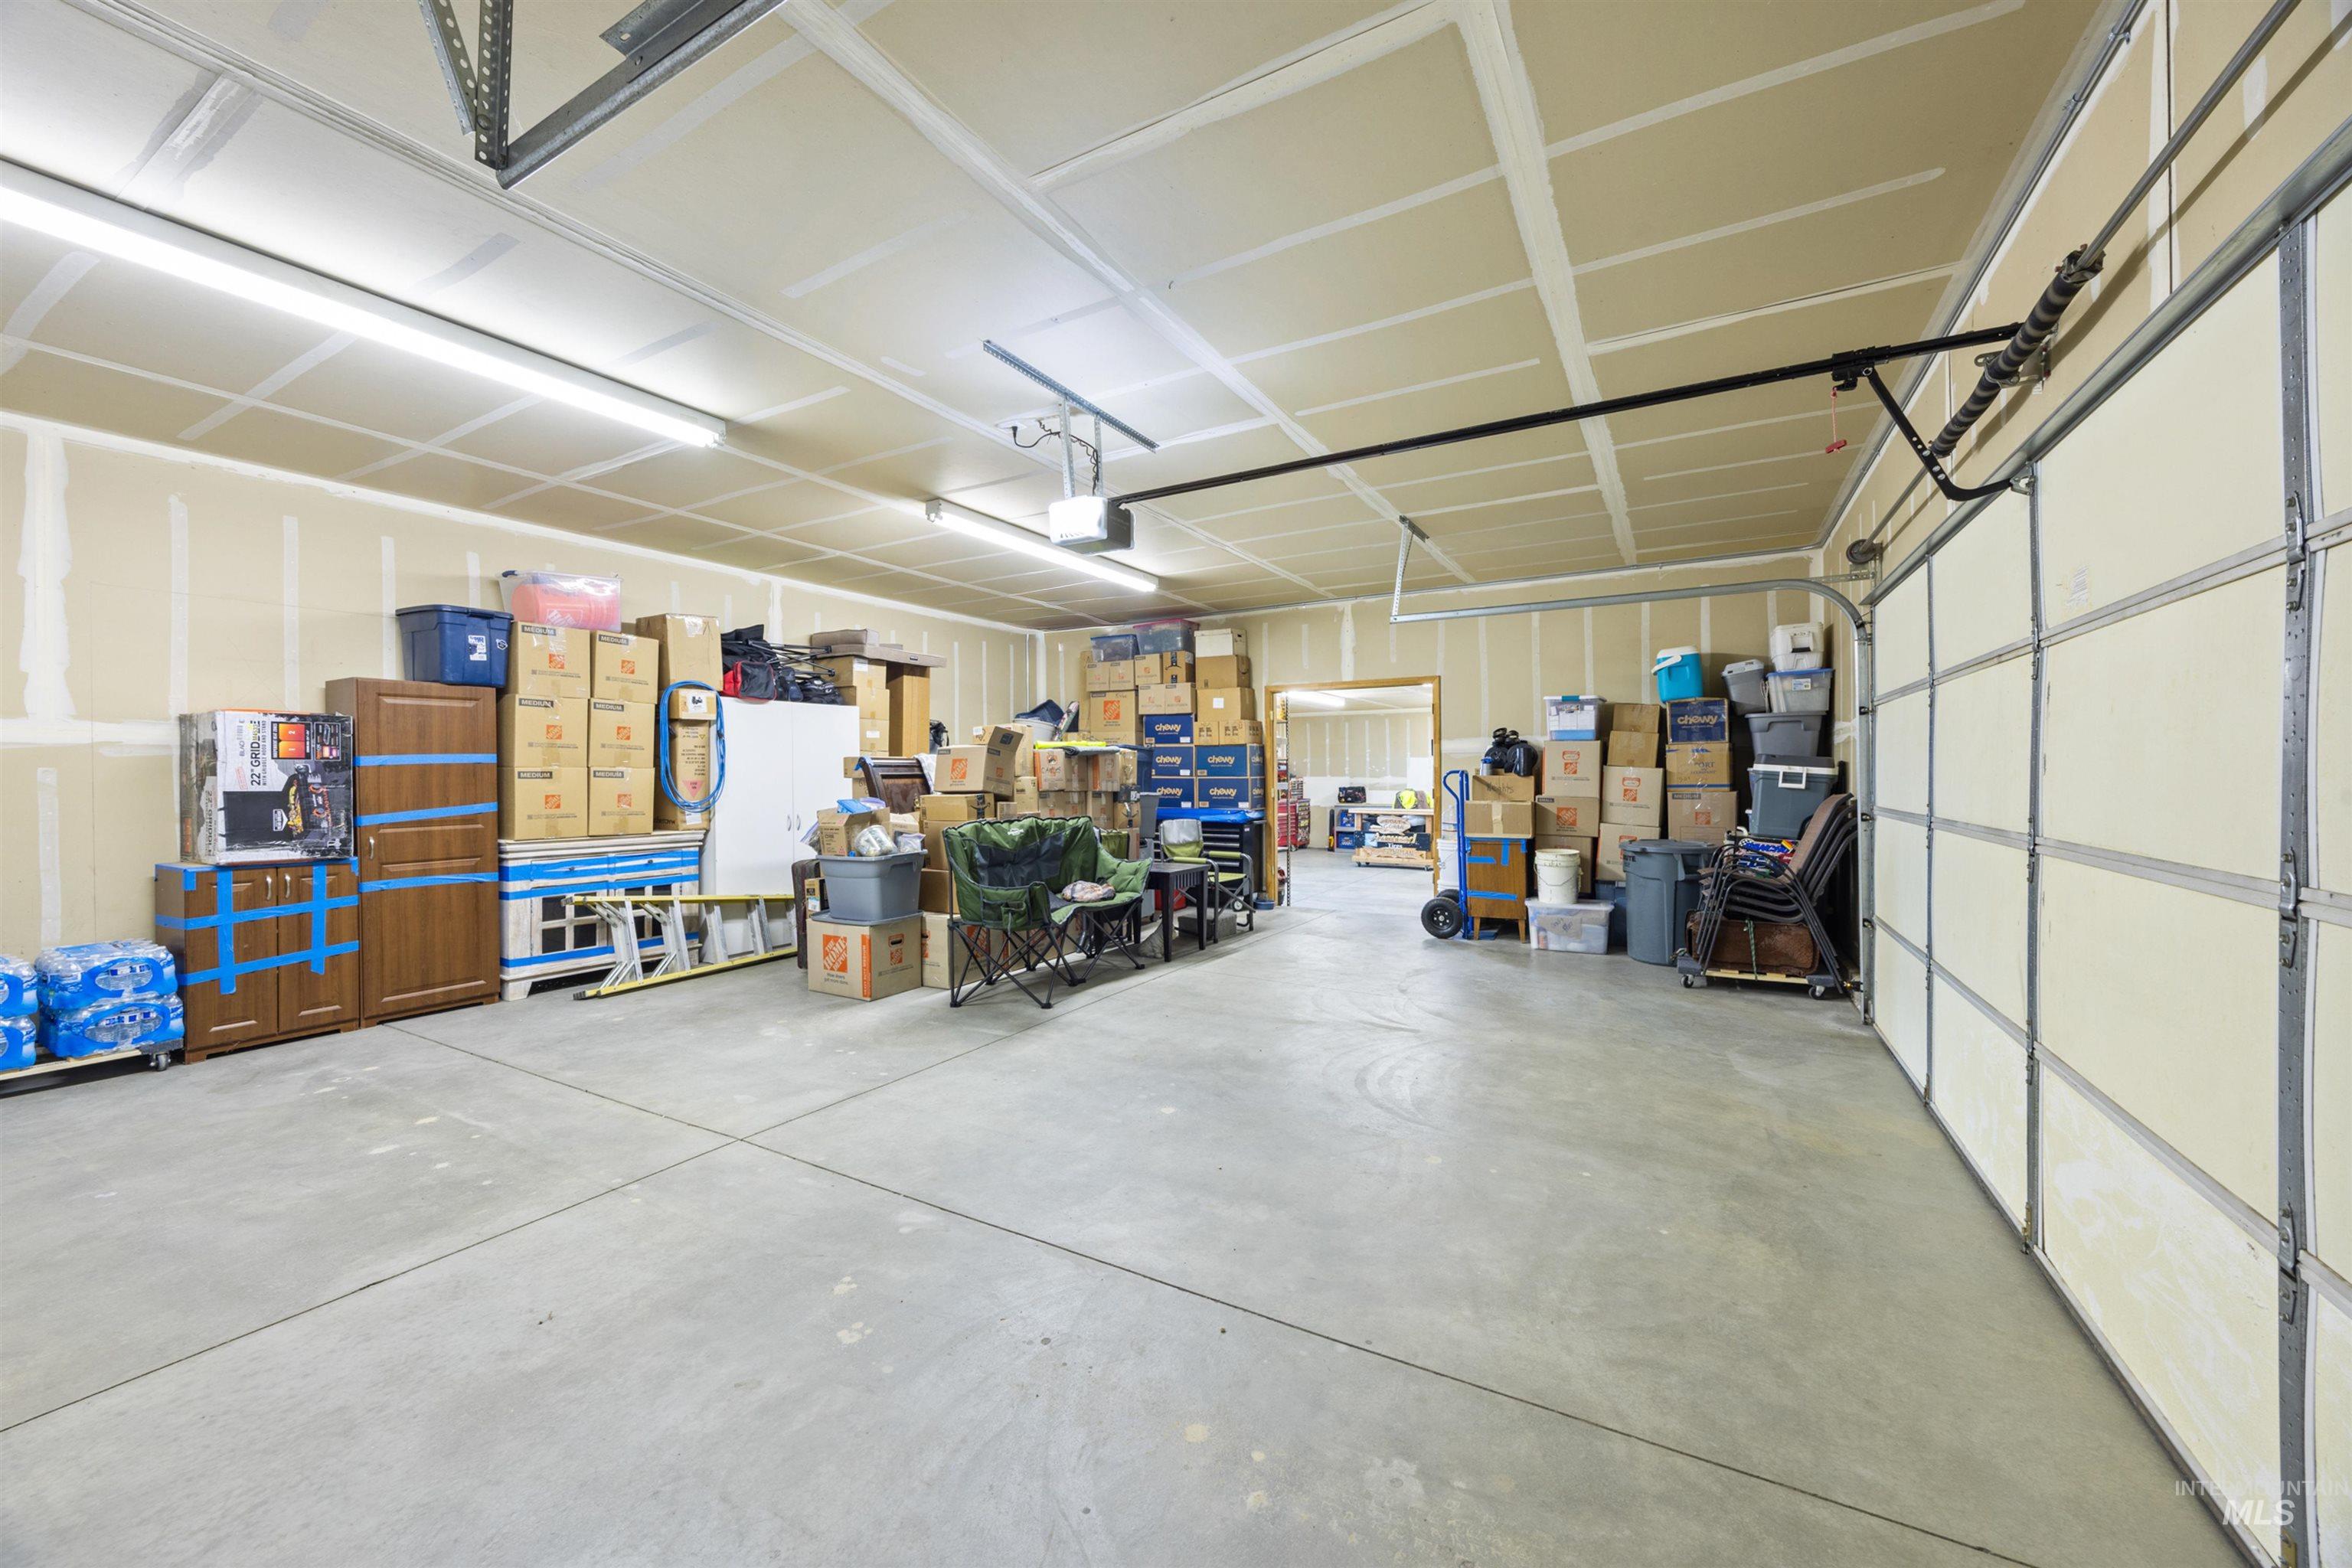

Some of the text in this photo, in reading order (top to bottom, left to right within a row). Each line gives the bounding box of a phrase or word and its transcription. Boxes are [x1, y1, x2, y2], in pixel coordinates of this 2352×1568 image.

[524, 626, 555, 635] MEDIUM
[1677, 714, 1718, 725] chewy
[1155, 724, 1181, 733] chewy
[1155, 755, 1182, 764] chewy
[1207, 755, 1235, 764] chewy
[250, 769, 261, 786] 22"
[1157, 786, 1183, 795] chewy
[1209, 787, 1236, 796] chewy
[824, 936, 847, 971] HOME
